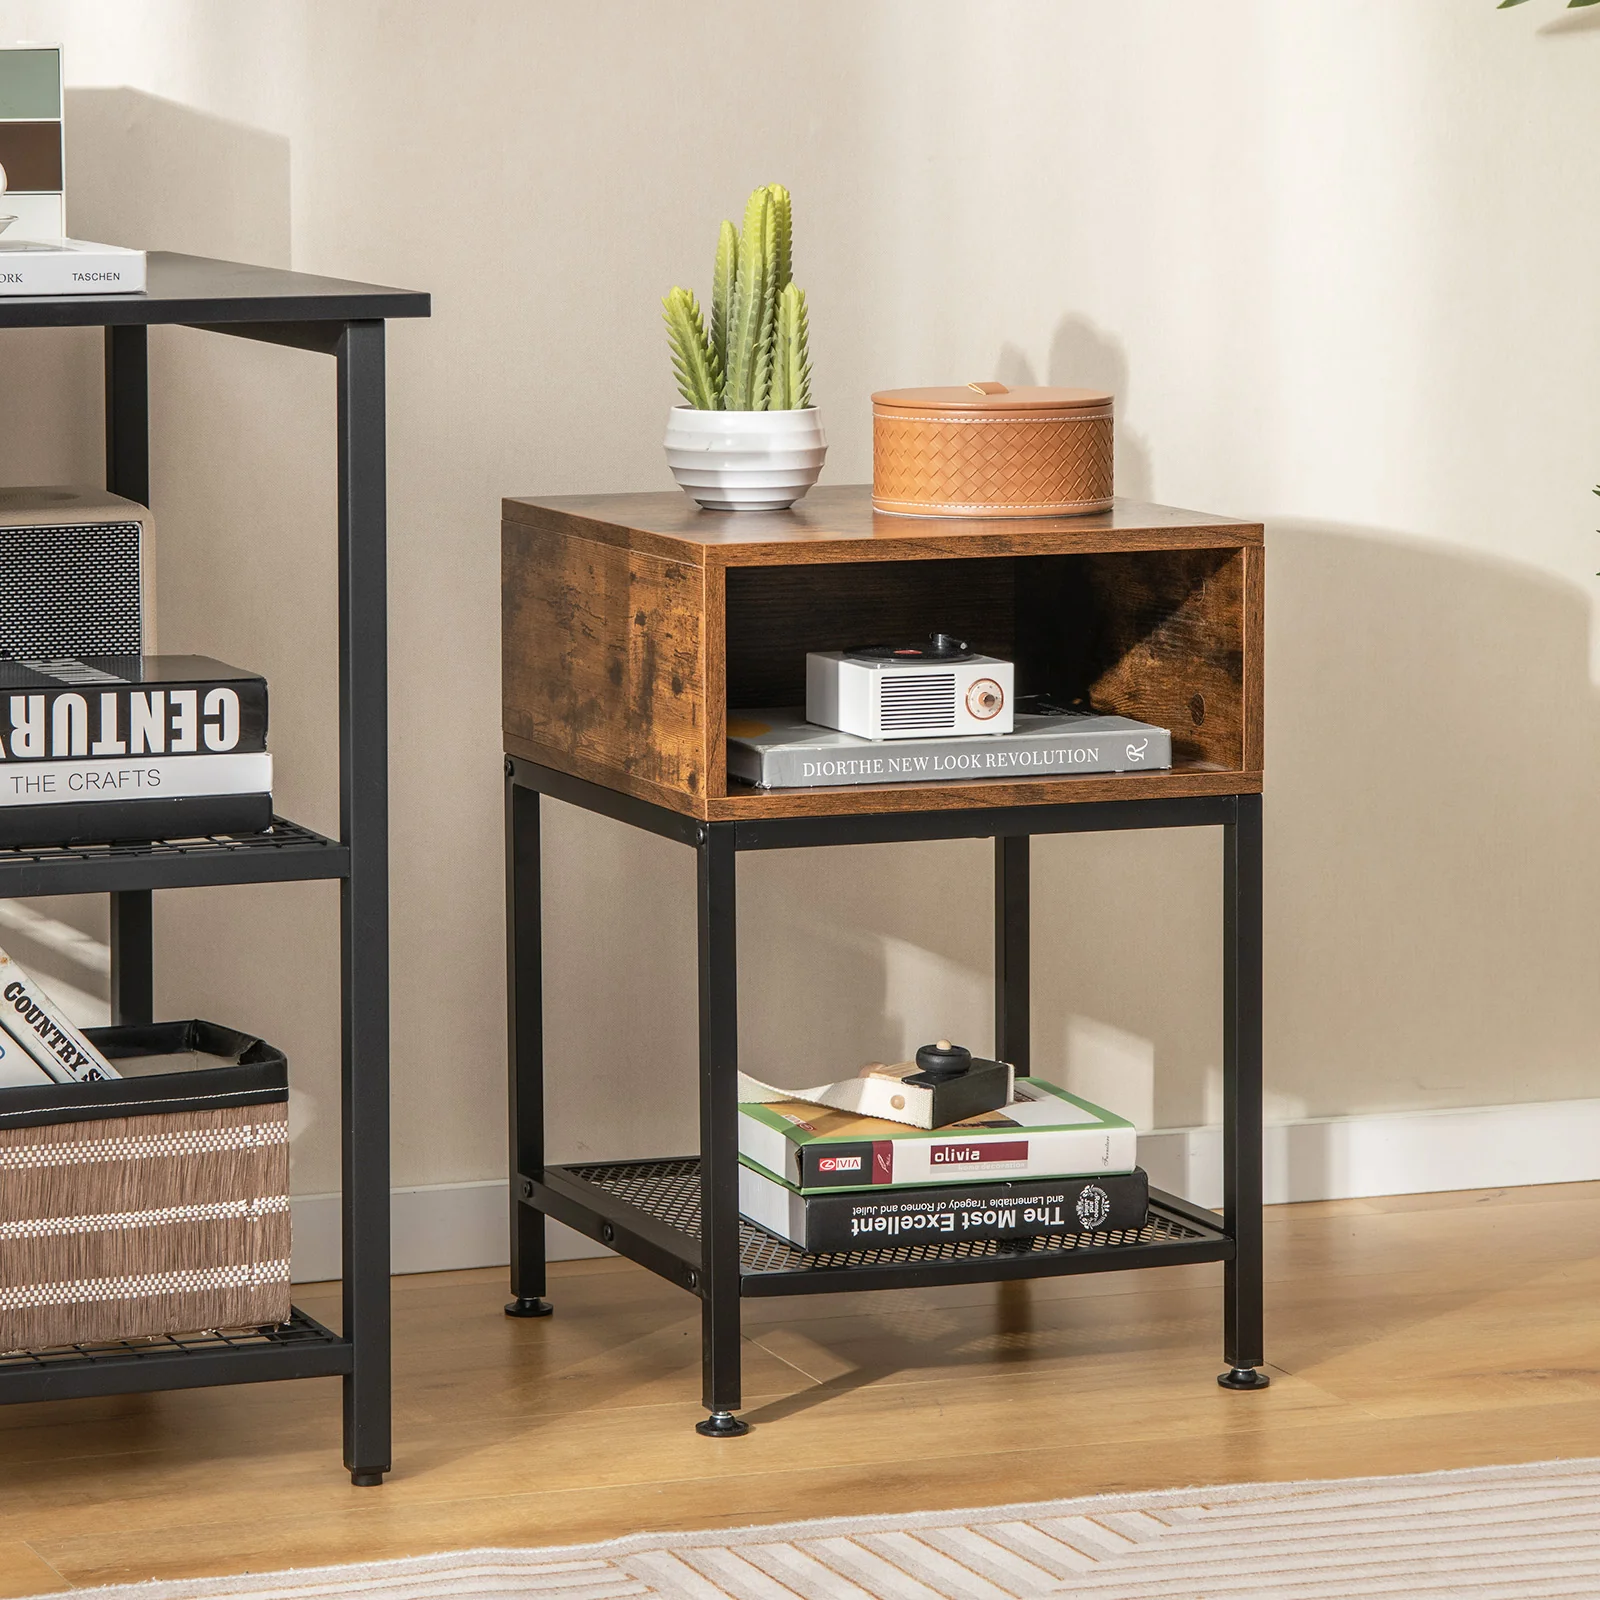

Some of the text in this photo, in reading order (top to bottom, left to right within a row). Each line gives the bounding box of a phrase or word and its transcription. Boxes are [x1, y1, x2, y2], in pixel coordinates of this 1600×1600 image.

[72, 272, 120, 281] TASCHEN
[0, 687, 240, 759] CENTUR
[888, 757, 929, 773] NEW
[934, 754, 982, 771] LOOK
[986, 748, 1099, 768] REVOLUTION
[10, 768, 161, 794] THE CRAFTS
[4, 981, 89, 1072] COUNTRY
[934, 1146, 980, 1162] olivia
[852, 1195, 1065, 1216] and Lamentable Tragedy of Romeo and Juliet
[851, 1206, 1065, 1237] The Most Excellent
